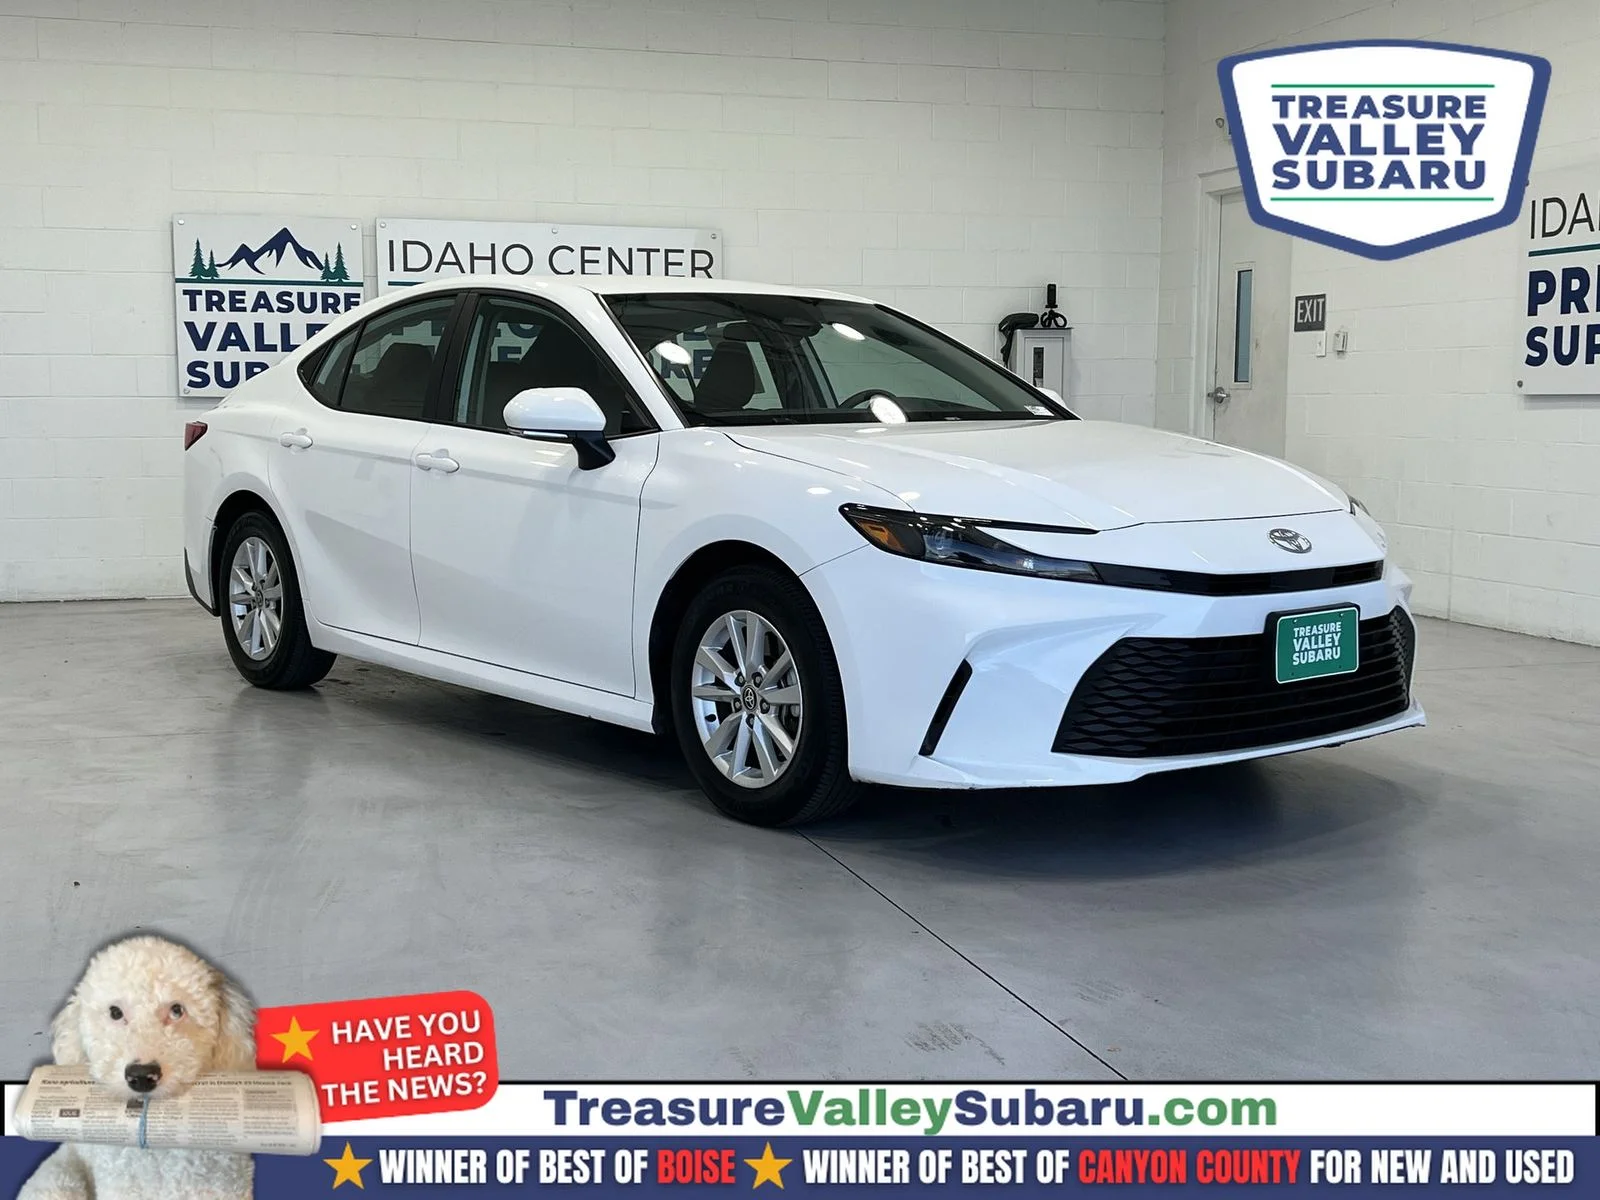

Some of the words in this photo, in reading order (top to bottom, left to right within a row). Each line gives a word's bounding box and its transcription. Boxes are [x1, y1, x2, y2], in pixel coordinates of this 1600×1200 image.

[1530, 193, 1600, 239] IDA
[388, 240, 533, 275] IDAHO
[548, 245, 715, 279] CENTER
[183, 289, 361, 314] TREASURE
[1527, 265, 1600, 317] PR
[1297, 298, 1325, 323] EXIT
[1293, 622, 1342, 638] TREASURE
[1293, 632, 1342, 651] VALLEY
[1292, 646, 1341, 666] SUBARU
